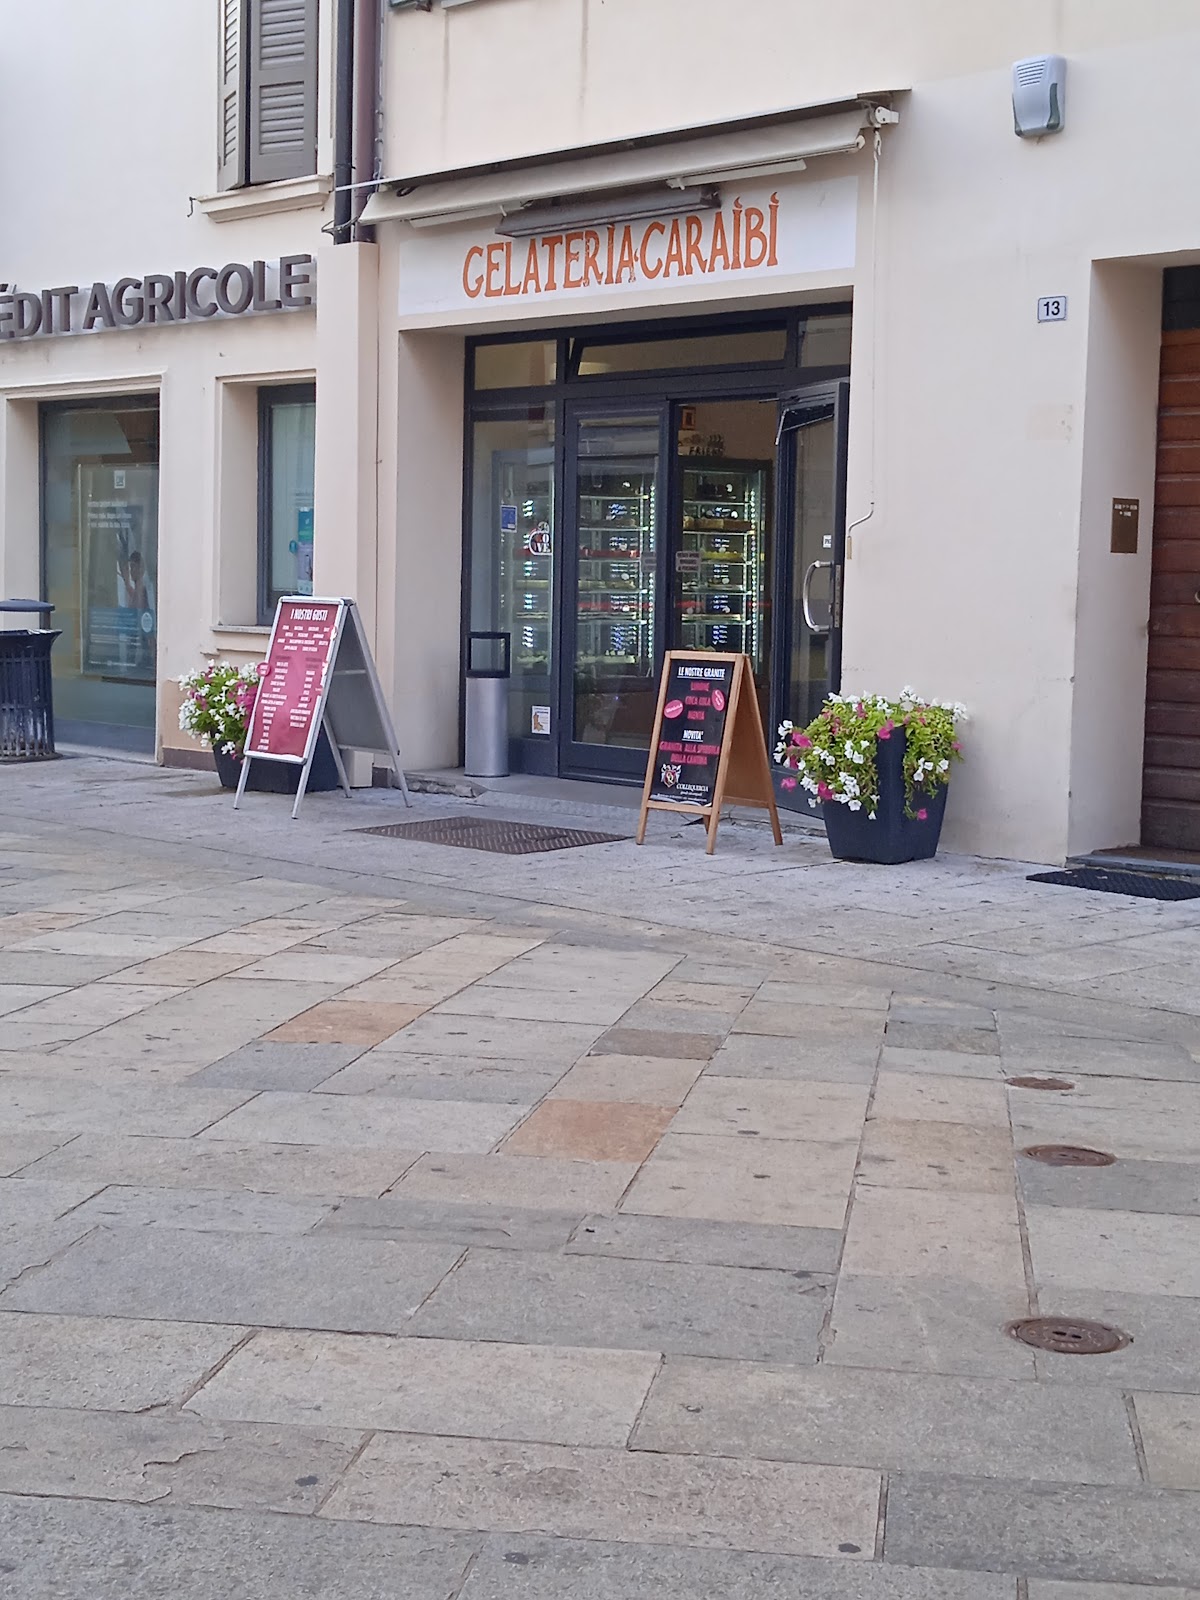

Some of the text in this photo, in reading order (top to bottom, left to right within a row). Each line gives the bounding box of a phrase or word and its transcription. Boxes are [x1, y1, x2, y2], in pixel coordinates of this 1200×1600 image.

[462, 191, 779, 298] GELATERIA CARAIBI
[83, 253, 313, 330] AGRICOLE
[1043, 300, 1060, 317] 13
[294, 609, 312, 621] NOSTRI
[312, 609, 328, 621] GUSTI
[678, 666, 726, 678] LE NOSTRE GRANITE
